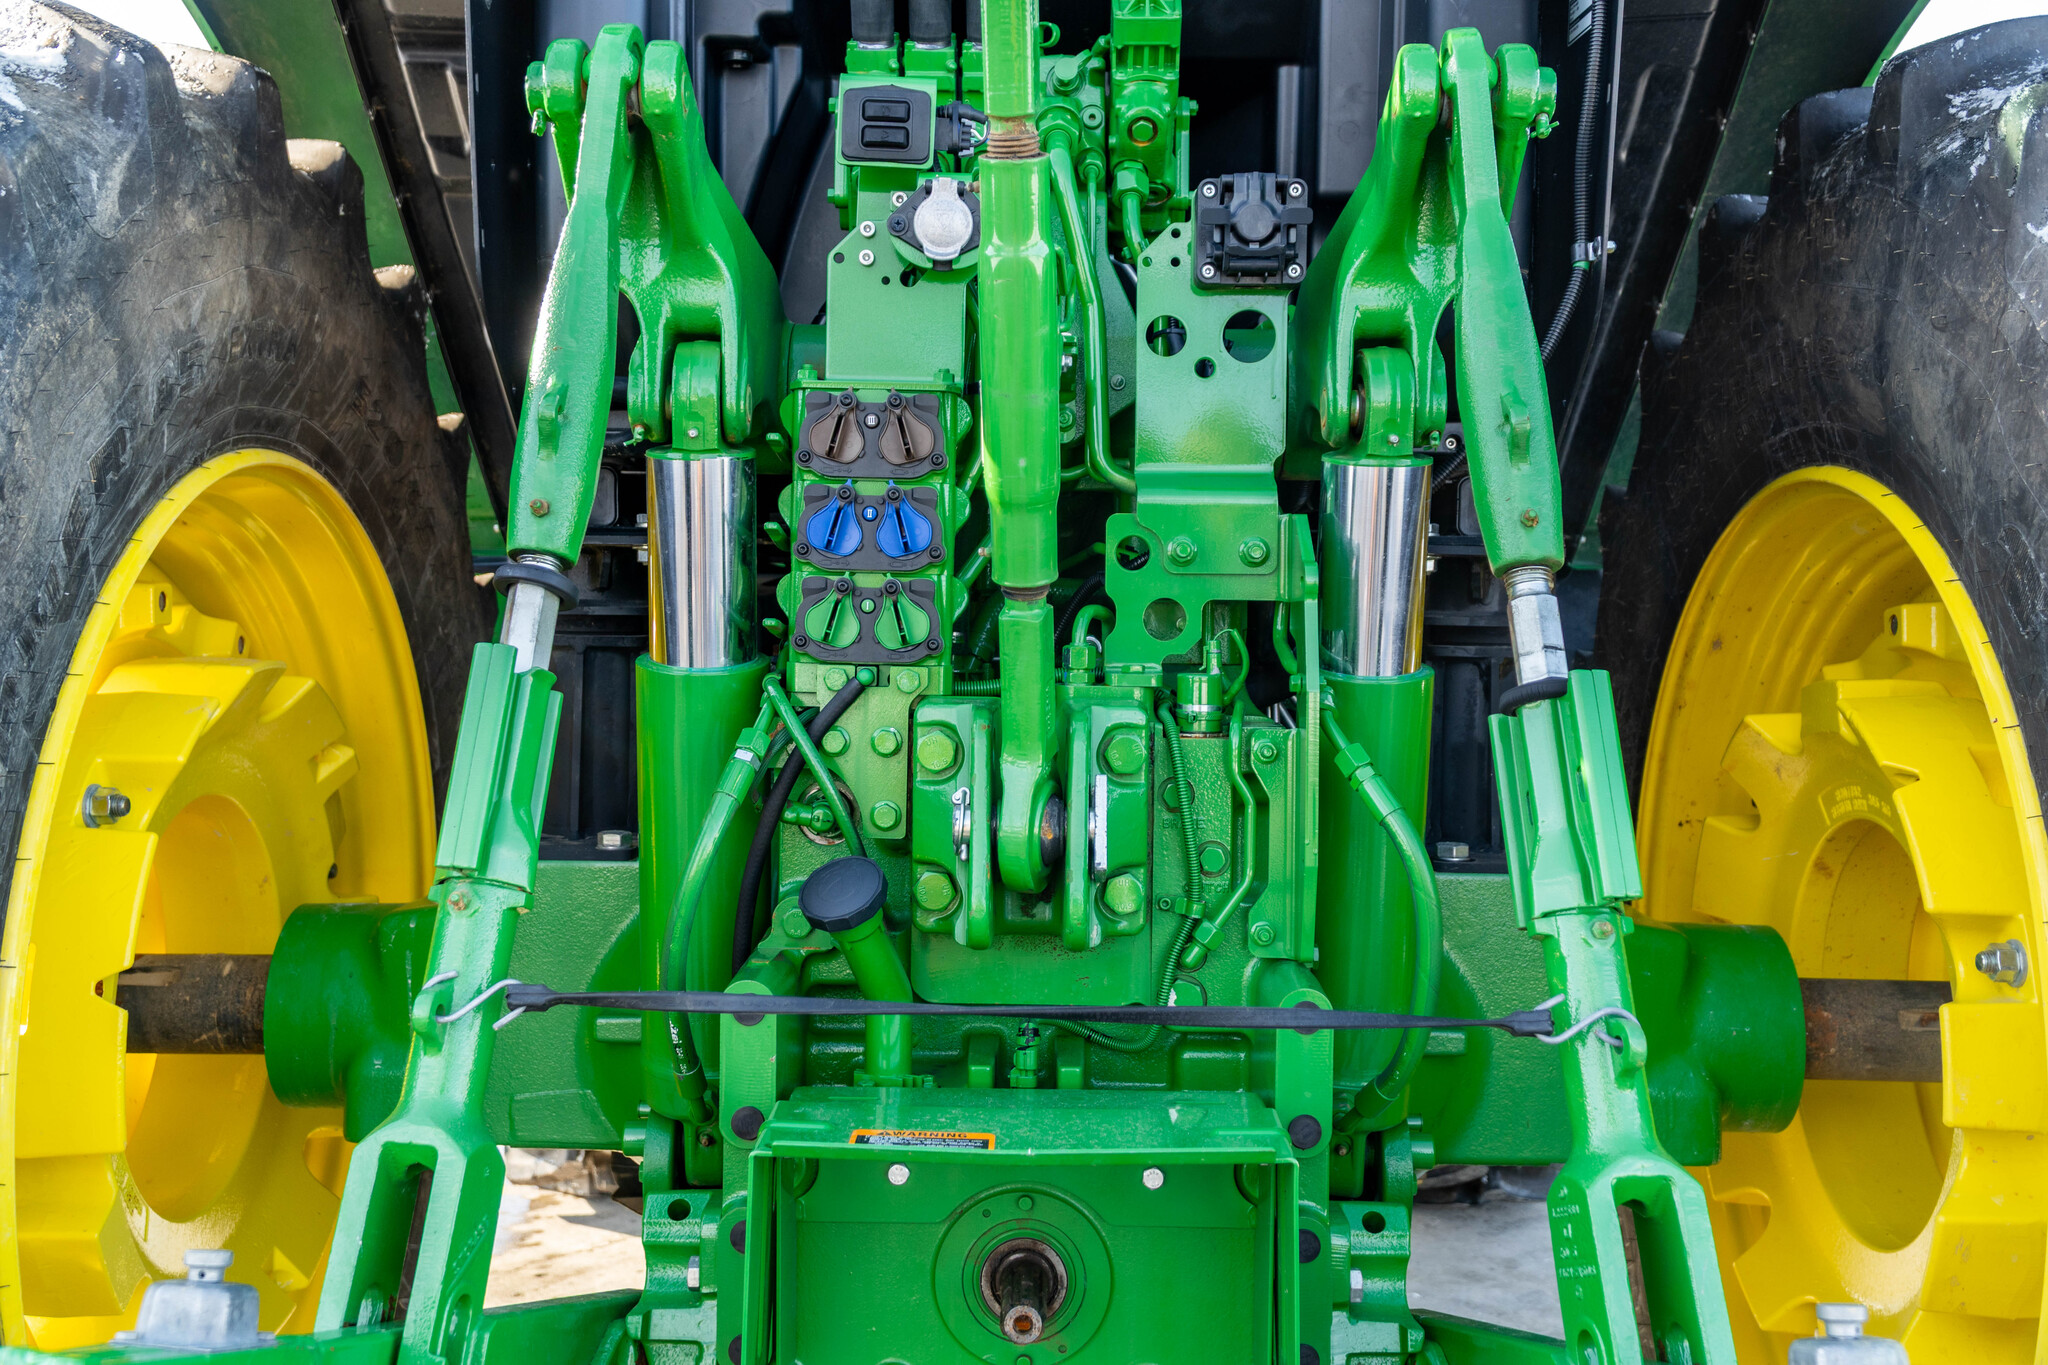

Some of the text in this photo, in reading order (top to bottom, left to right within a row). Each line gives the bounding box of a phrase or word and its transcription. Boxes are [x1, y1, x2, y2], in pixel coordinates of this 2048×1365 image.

[867, 415, 876, 425] III
[866, 509, 873, 518] II
[1163, 817, 1206, 830] BRE
[893, 1131, 968, 1139] WARNING
